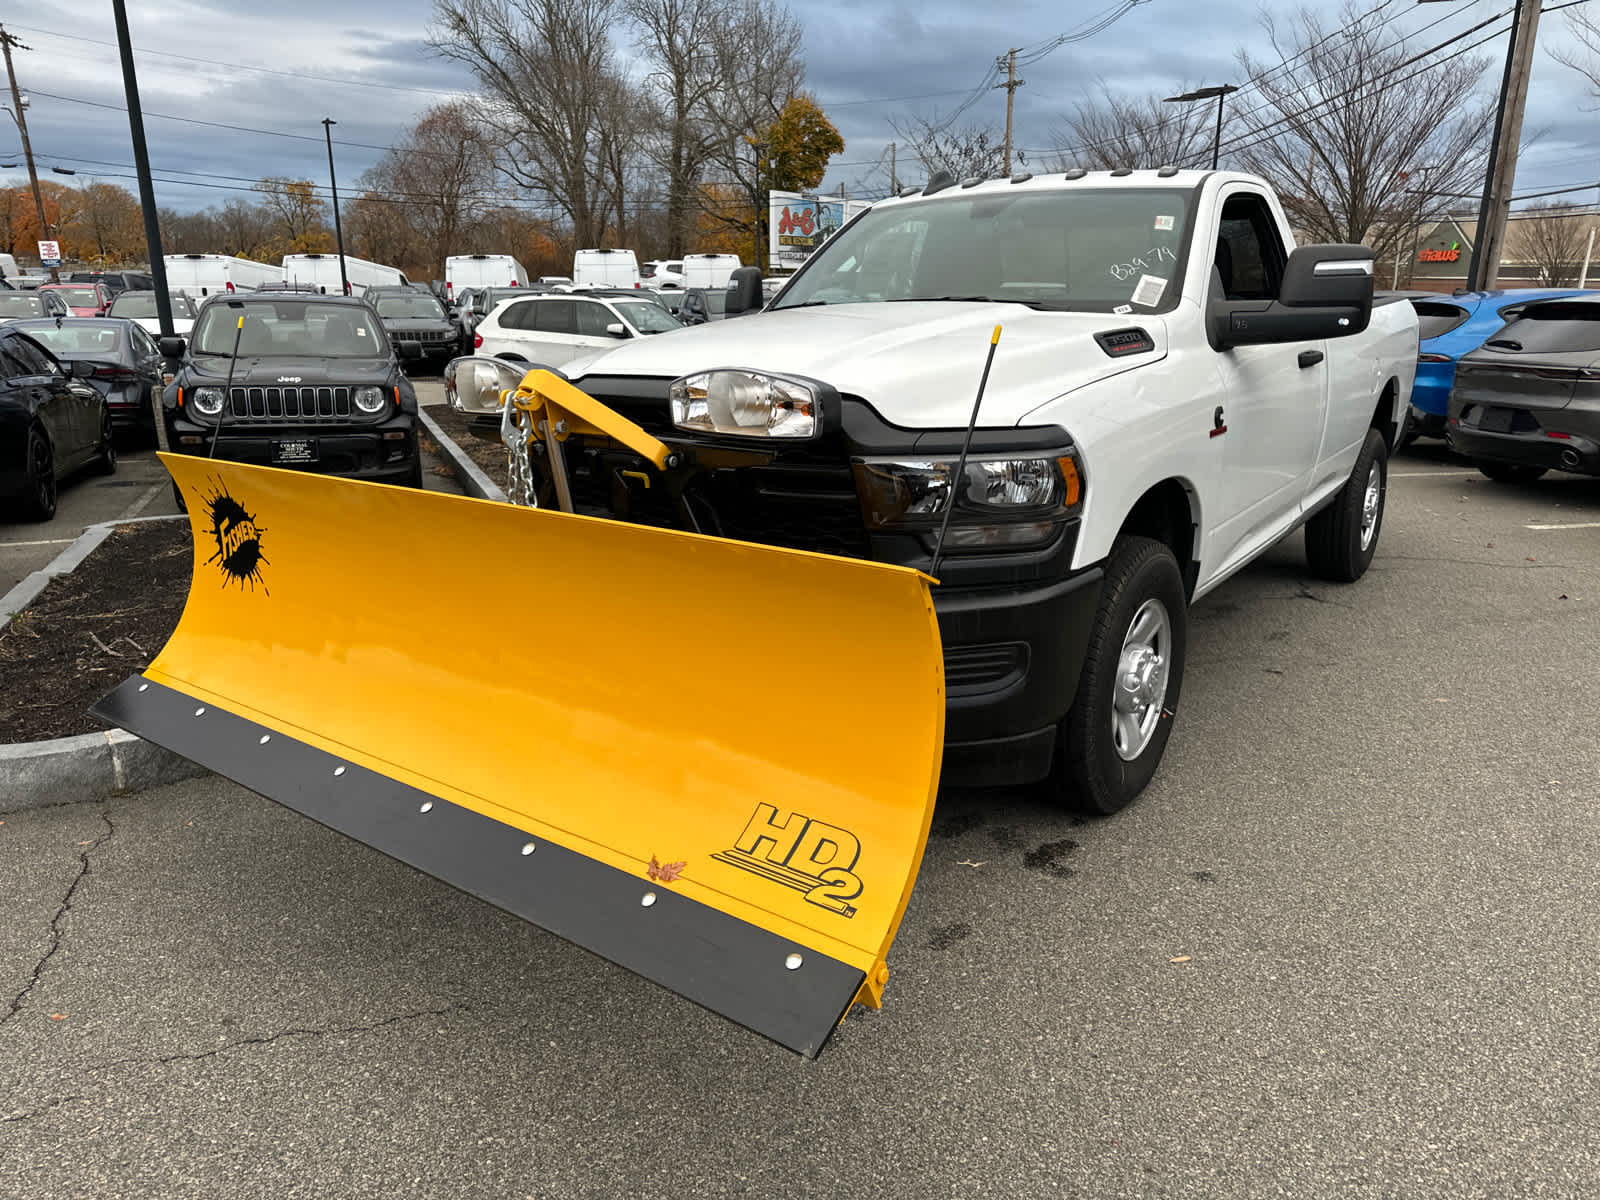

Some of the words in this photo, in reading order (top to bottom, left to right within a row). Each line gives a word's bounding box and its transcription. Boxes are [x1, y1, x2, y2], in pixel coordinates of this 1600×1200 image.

[778, 206, 815, 235] A&E
[277, 376, 302, 384] Jeep
[219, 516, 259, 561] FISHER
